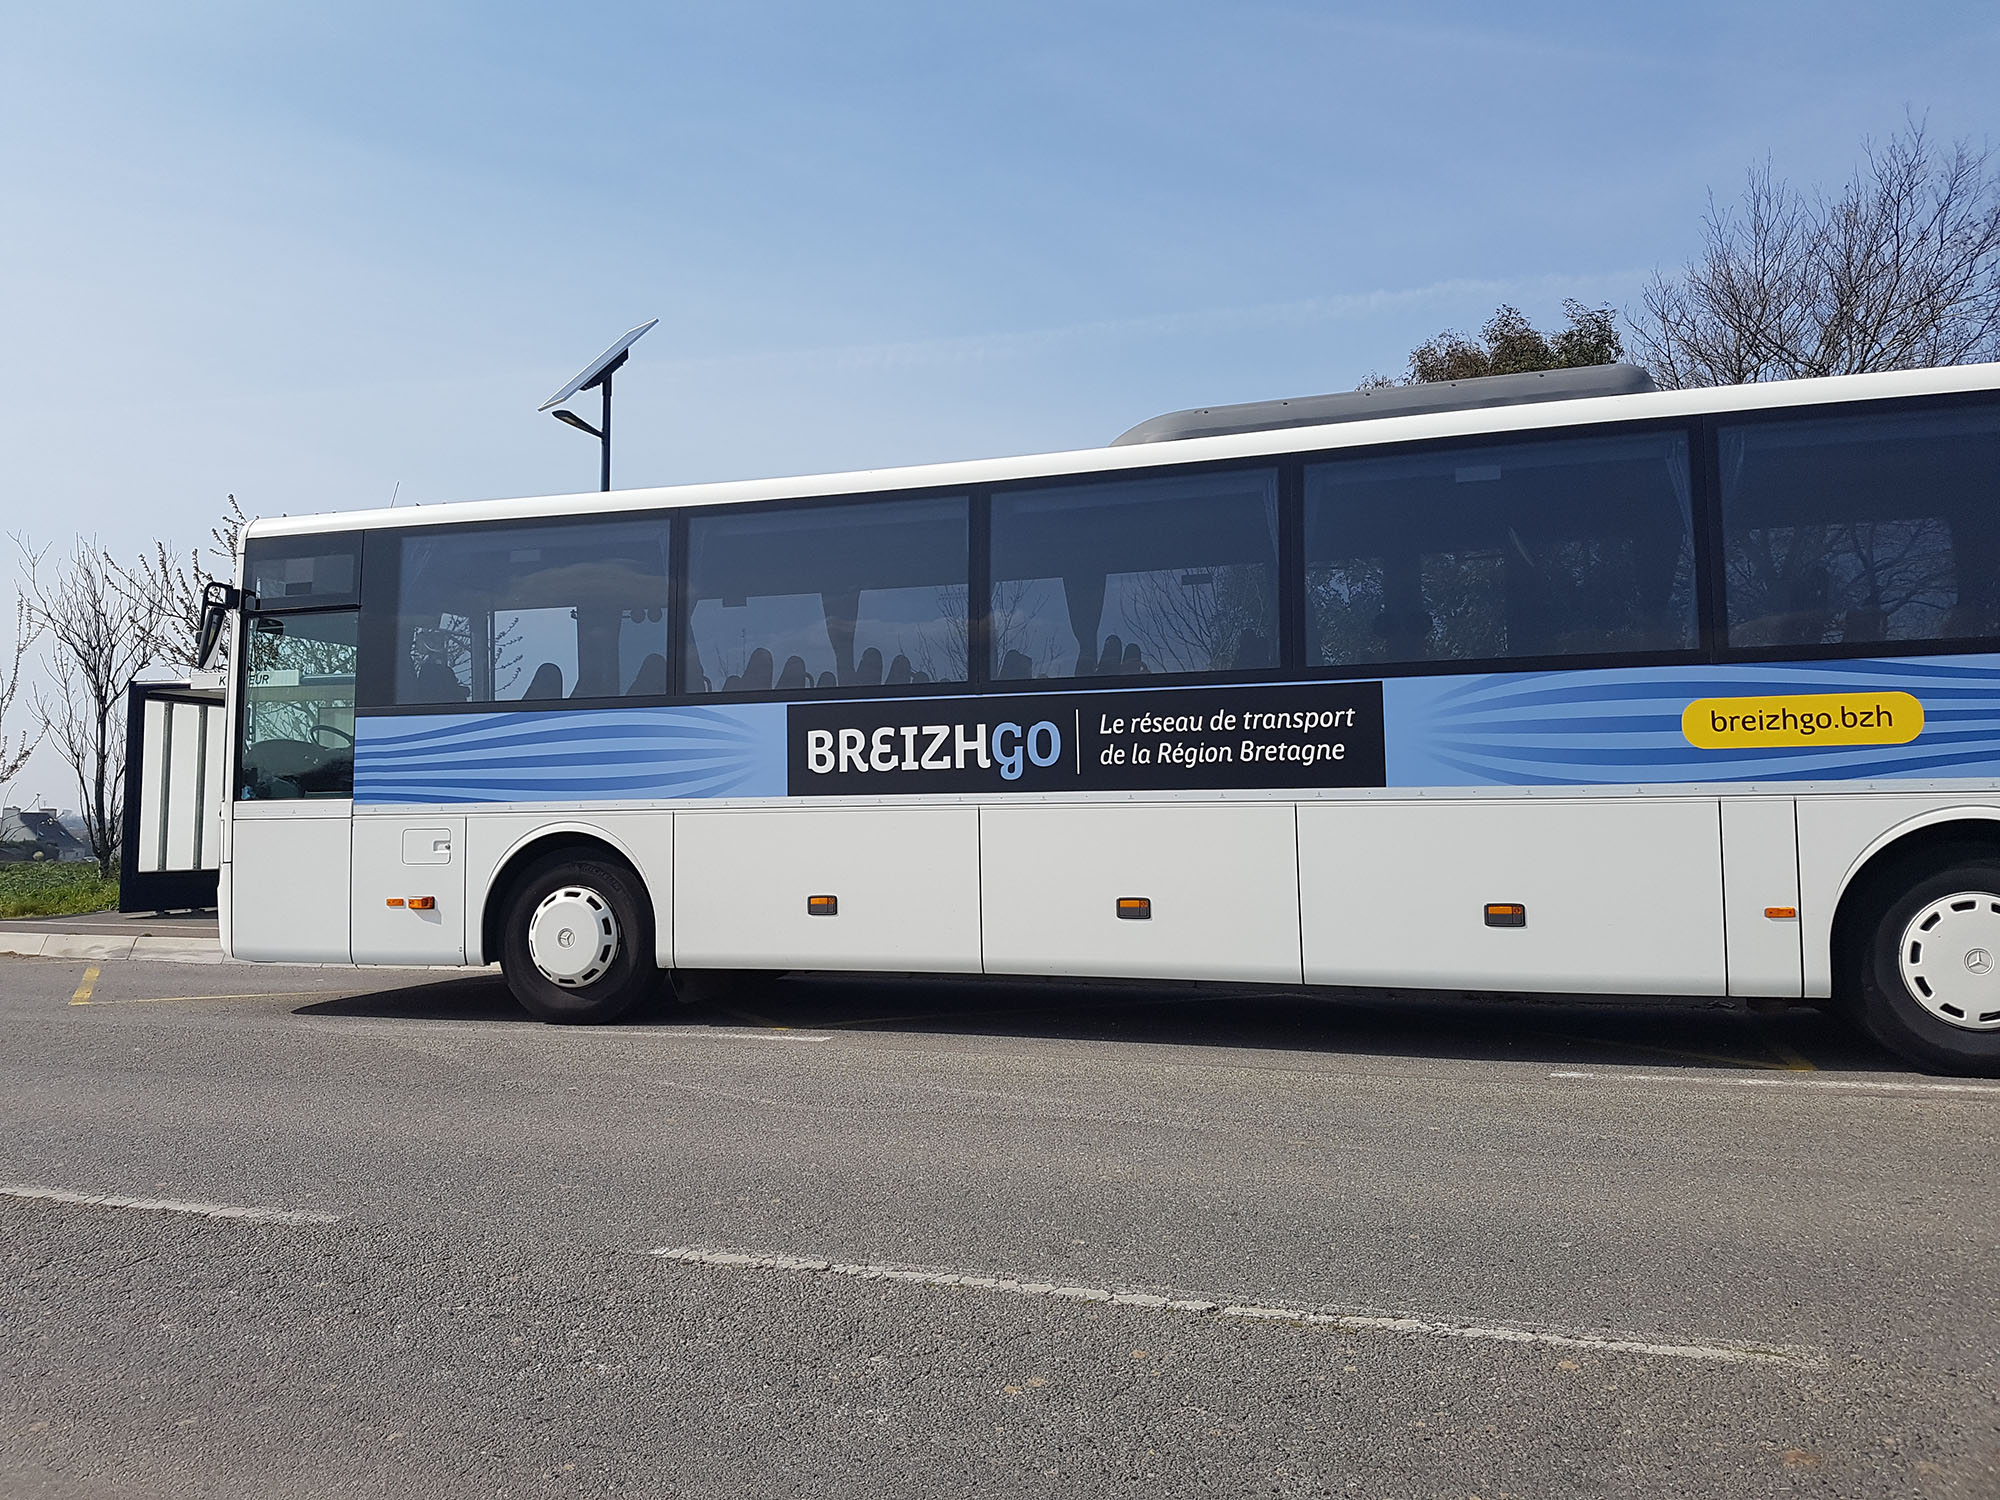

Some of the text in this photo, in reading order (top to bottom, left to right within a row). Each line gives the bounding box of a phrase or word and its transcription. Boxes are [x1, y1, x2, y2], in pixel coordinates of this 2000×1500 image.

[1099, 707, 1356, 735] Le réseau de transport
[1710, 704, 1893, 736] breizhgo.bzh
[1099, 740, 1345, 769] de la Région Bretagne
